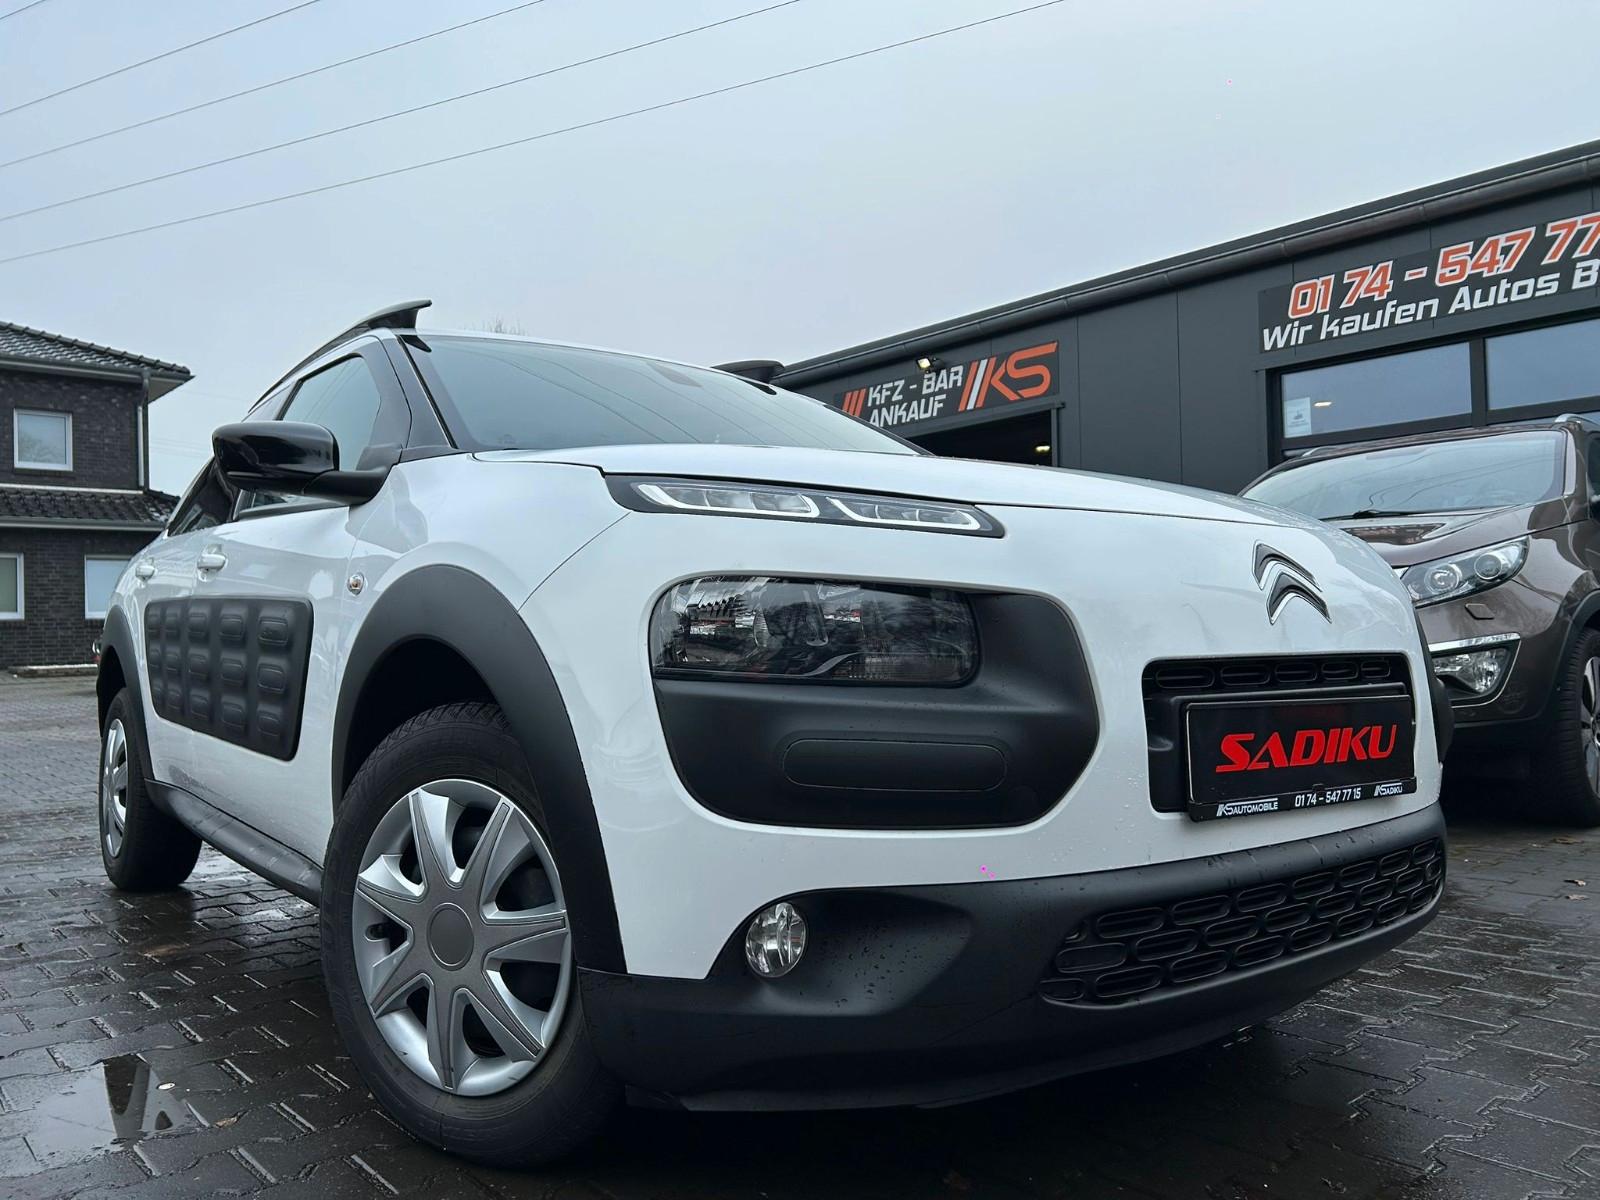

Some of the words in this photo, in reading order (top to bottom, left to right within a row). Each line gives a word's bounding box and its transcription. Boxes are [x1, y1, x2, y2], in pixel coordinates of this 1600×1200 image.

[1435, 226, 1536, 287] 547
[1263, 320, 1312, 351] Wir
[1320, 298, 1439, 340] kaufen
[1448, 273, 1560, 314] Autos
[867, 379, 905, 407] KFZ
[922, 365, 964, 395] BAR
[869, 394, 947, 428] ANKAUF
[1216, 724, 1397, 773] SADIKU
